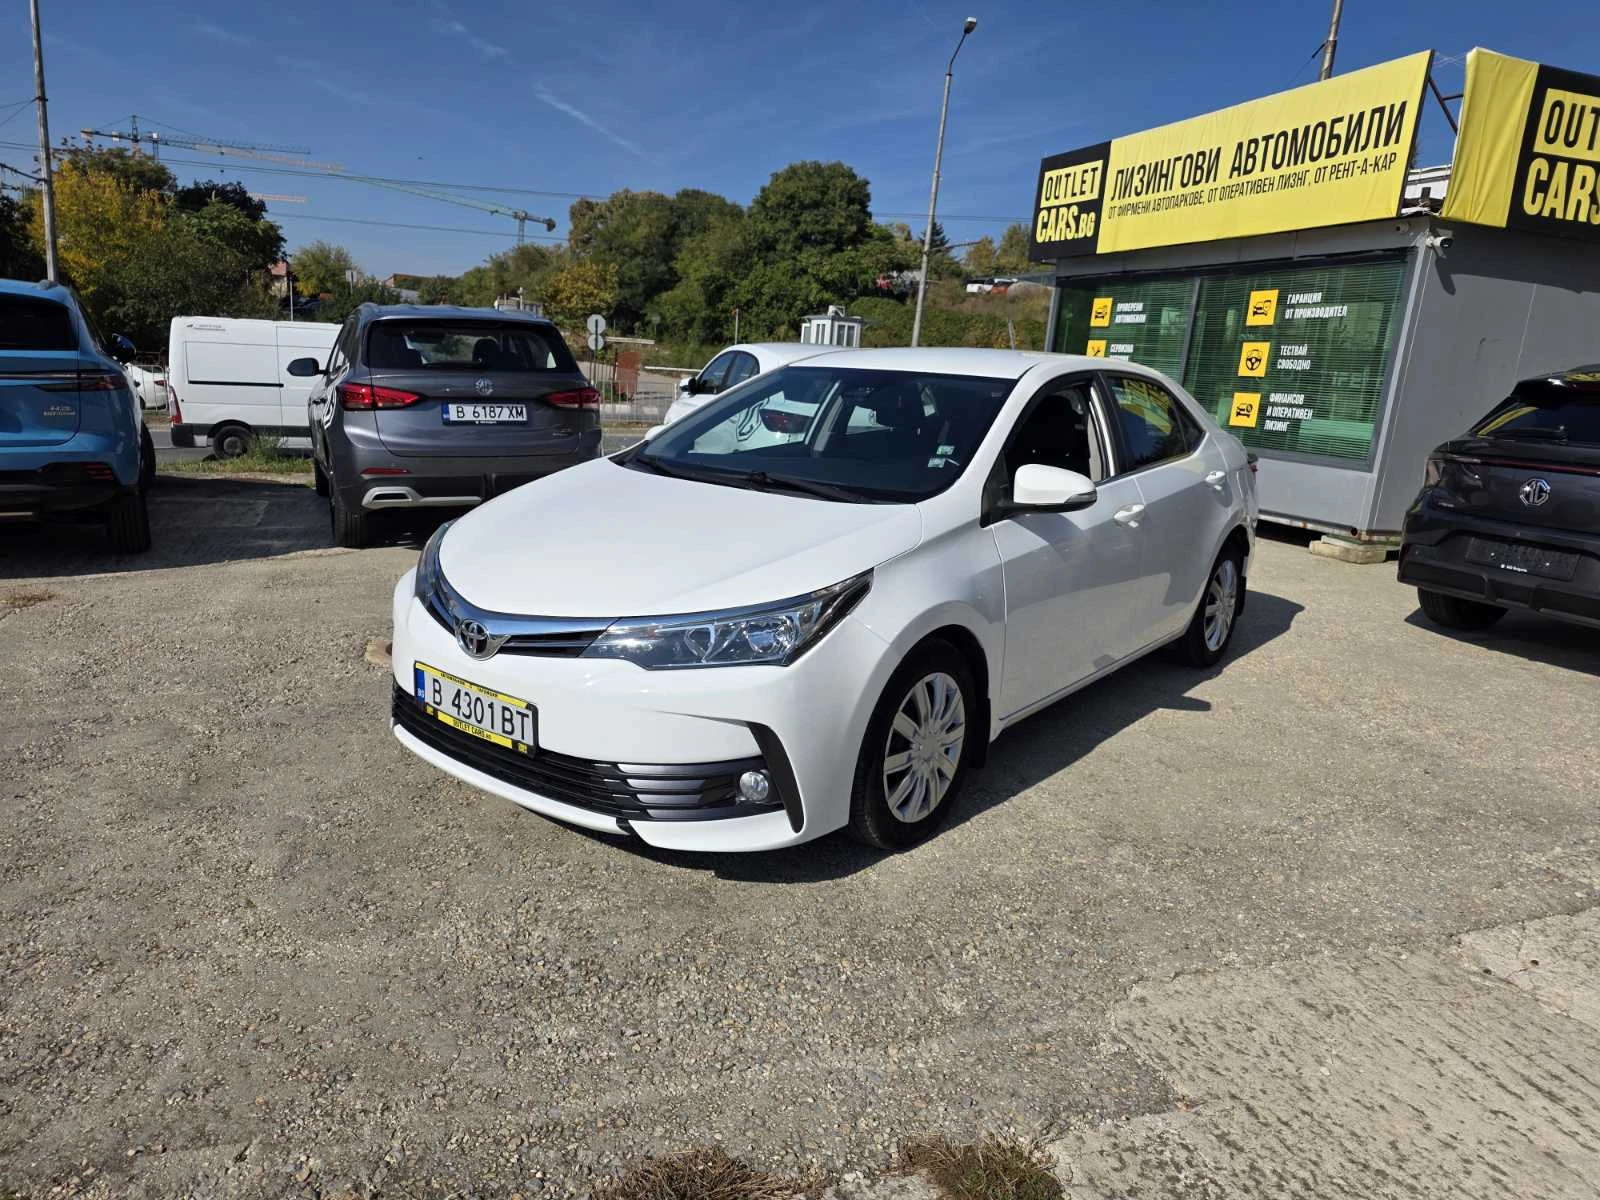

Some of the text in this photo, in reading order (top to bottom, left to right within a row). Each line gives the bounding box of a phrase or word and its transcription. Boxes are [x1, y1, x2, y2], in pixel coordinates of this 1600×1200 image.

[1110, 101, 1408, 201] ЛИЗИНГОВИ АВТОМОБИЛИ
[1045, 167, 1098, 201] OUTLET
[1108, 205, 1117, 219] ОТ
[1117, 202, 1152, 217] ФИРМЕНИ
[1151, 190, 1206, 212] АВТОПАРКОВЕ,
[1207, 188, 1220, 203] ОТ
[1219, 178, 1275, 201] ОПЕРАТИВЕН
[1314, 165, 1329, 185] ОТ
[1329, 152, 1398, 181] РЕНТ-А-КАР
[1036, 205, 1096, 243] CARS.BG
[1286, 292, 1323, 305] ГАРАНЦИЯ
[1285, 306, 1348, 319] ОТ ПРОИЗВОДИТЕЛ
[1280, 344, 1308, 356] ТЕСТВАЙ
[1277, 359, 1311, 370] СВОБОДНО
[472, 405, 504, 419] 6187
[432, 678, 442, 706] B
[452, 688, 495, 730] 4301
[502, 705, 530, 741] BT
